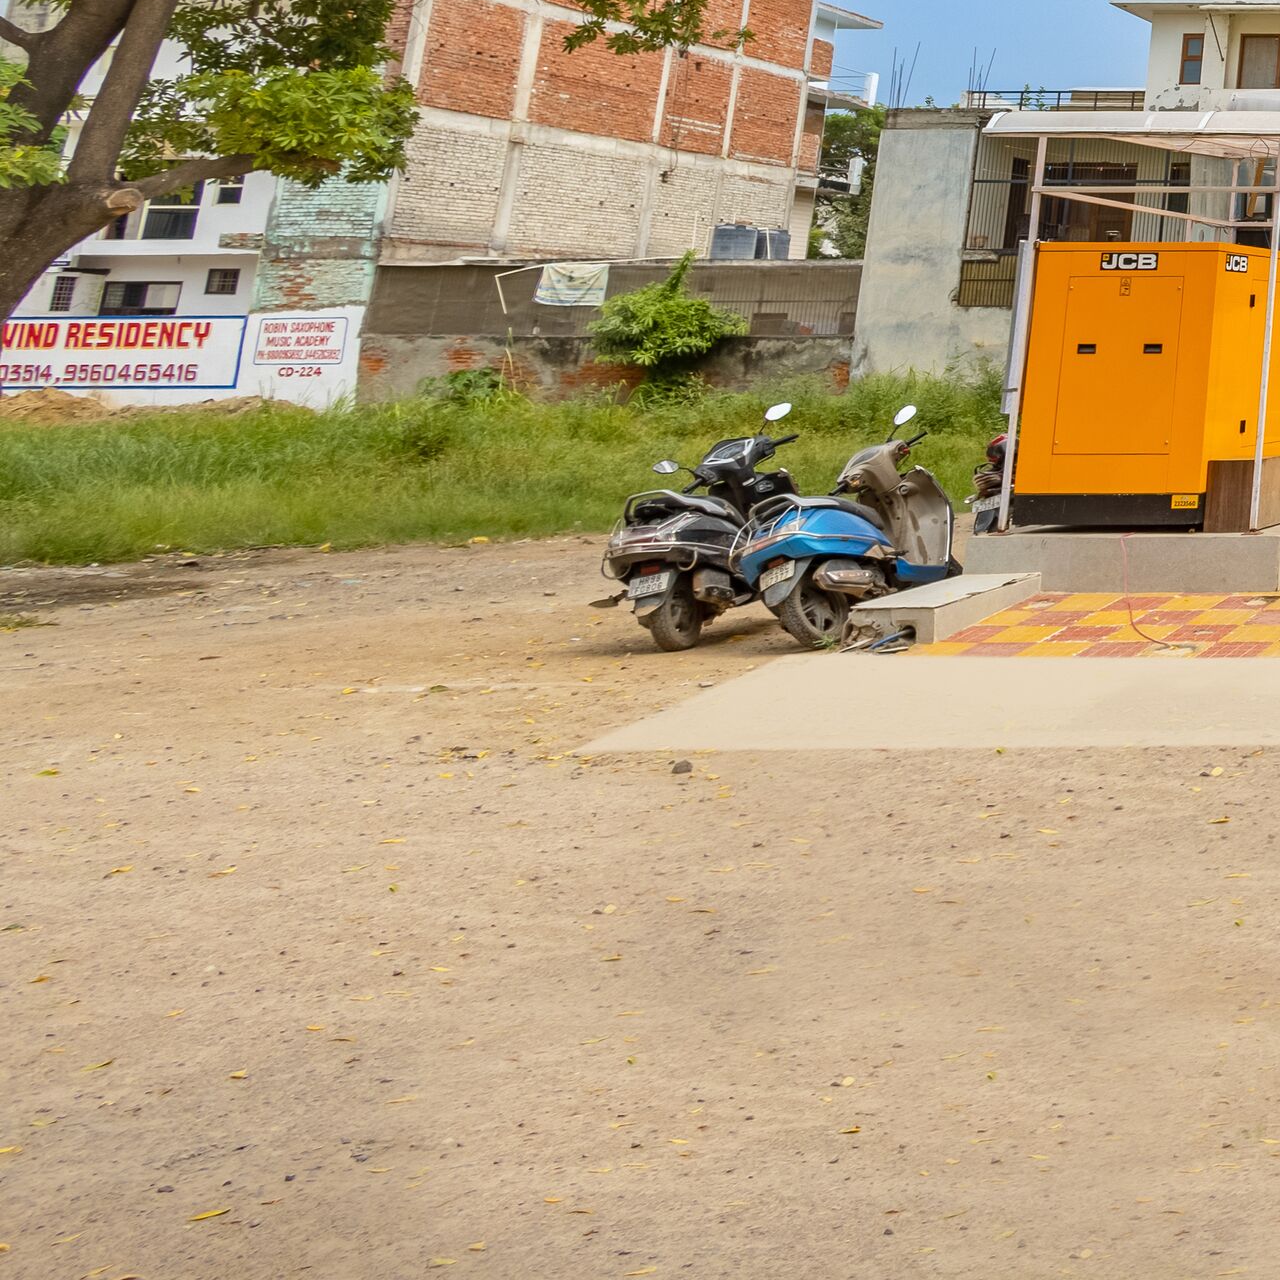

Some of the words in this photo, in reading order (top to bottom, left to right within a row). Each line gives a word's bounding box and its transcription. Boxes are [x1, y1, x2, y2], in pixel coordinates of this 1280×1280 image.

[1102, 254, 1157, 269] JCB
[1226, 256, 1248, 272] JCB
[290, 321, 336, 333] SAXOPHONE
[64, 322, 212, 349] RESIDENCY
[265, 336, 292, 347] MUSIC
[294, 335, 331, 347] ACADEMY
[277, 366, 322, 378] CD-224
